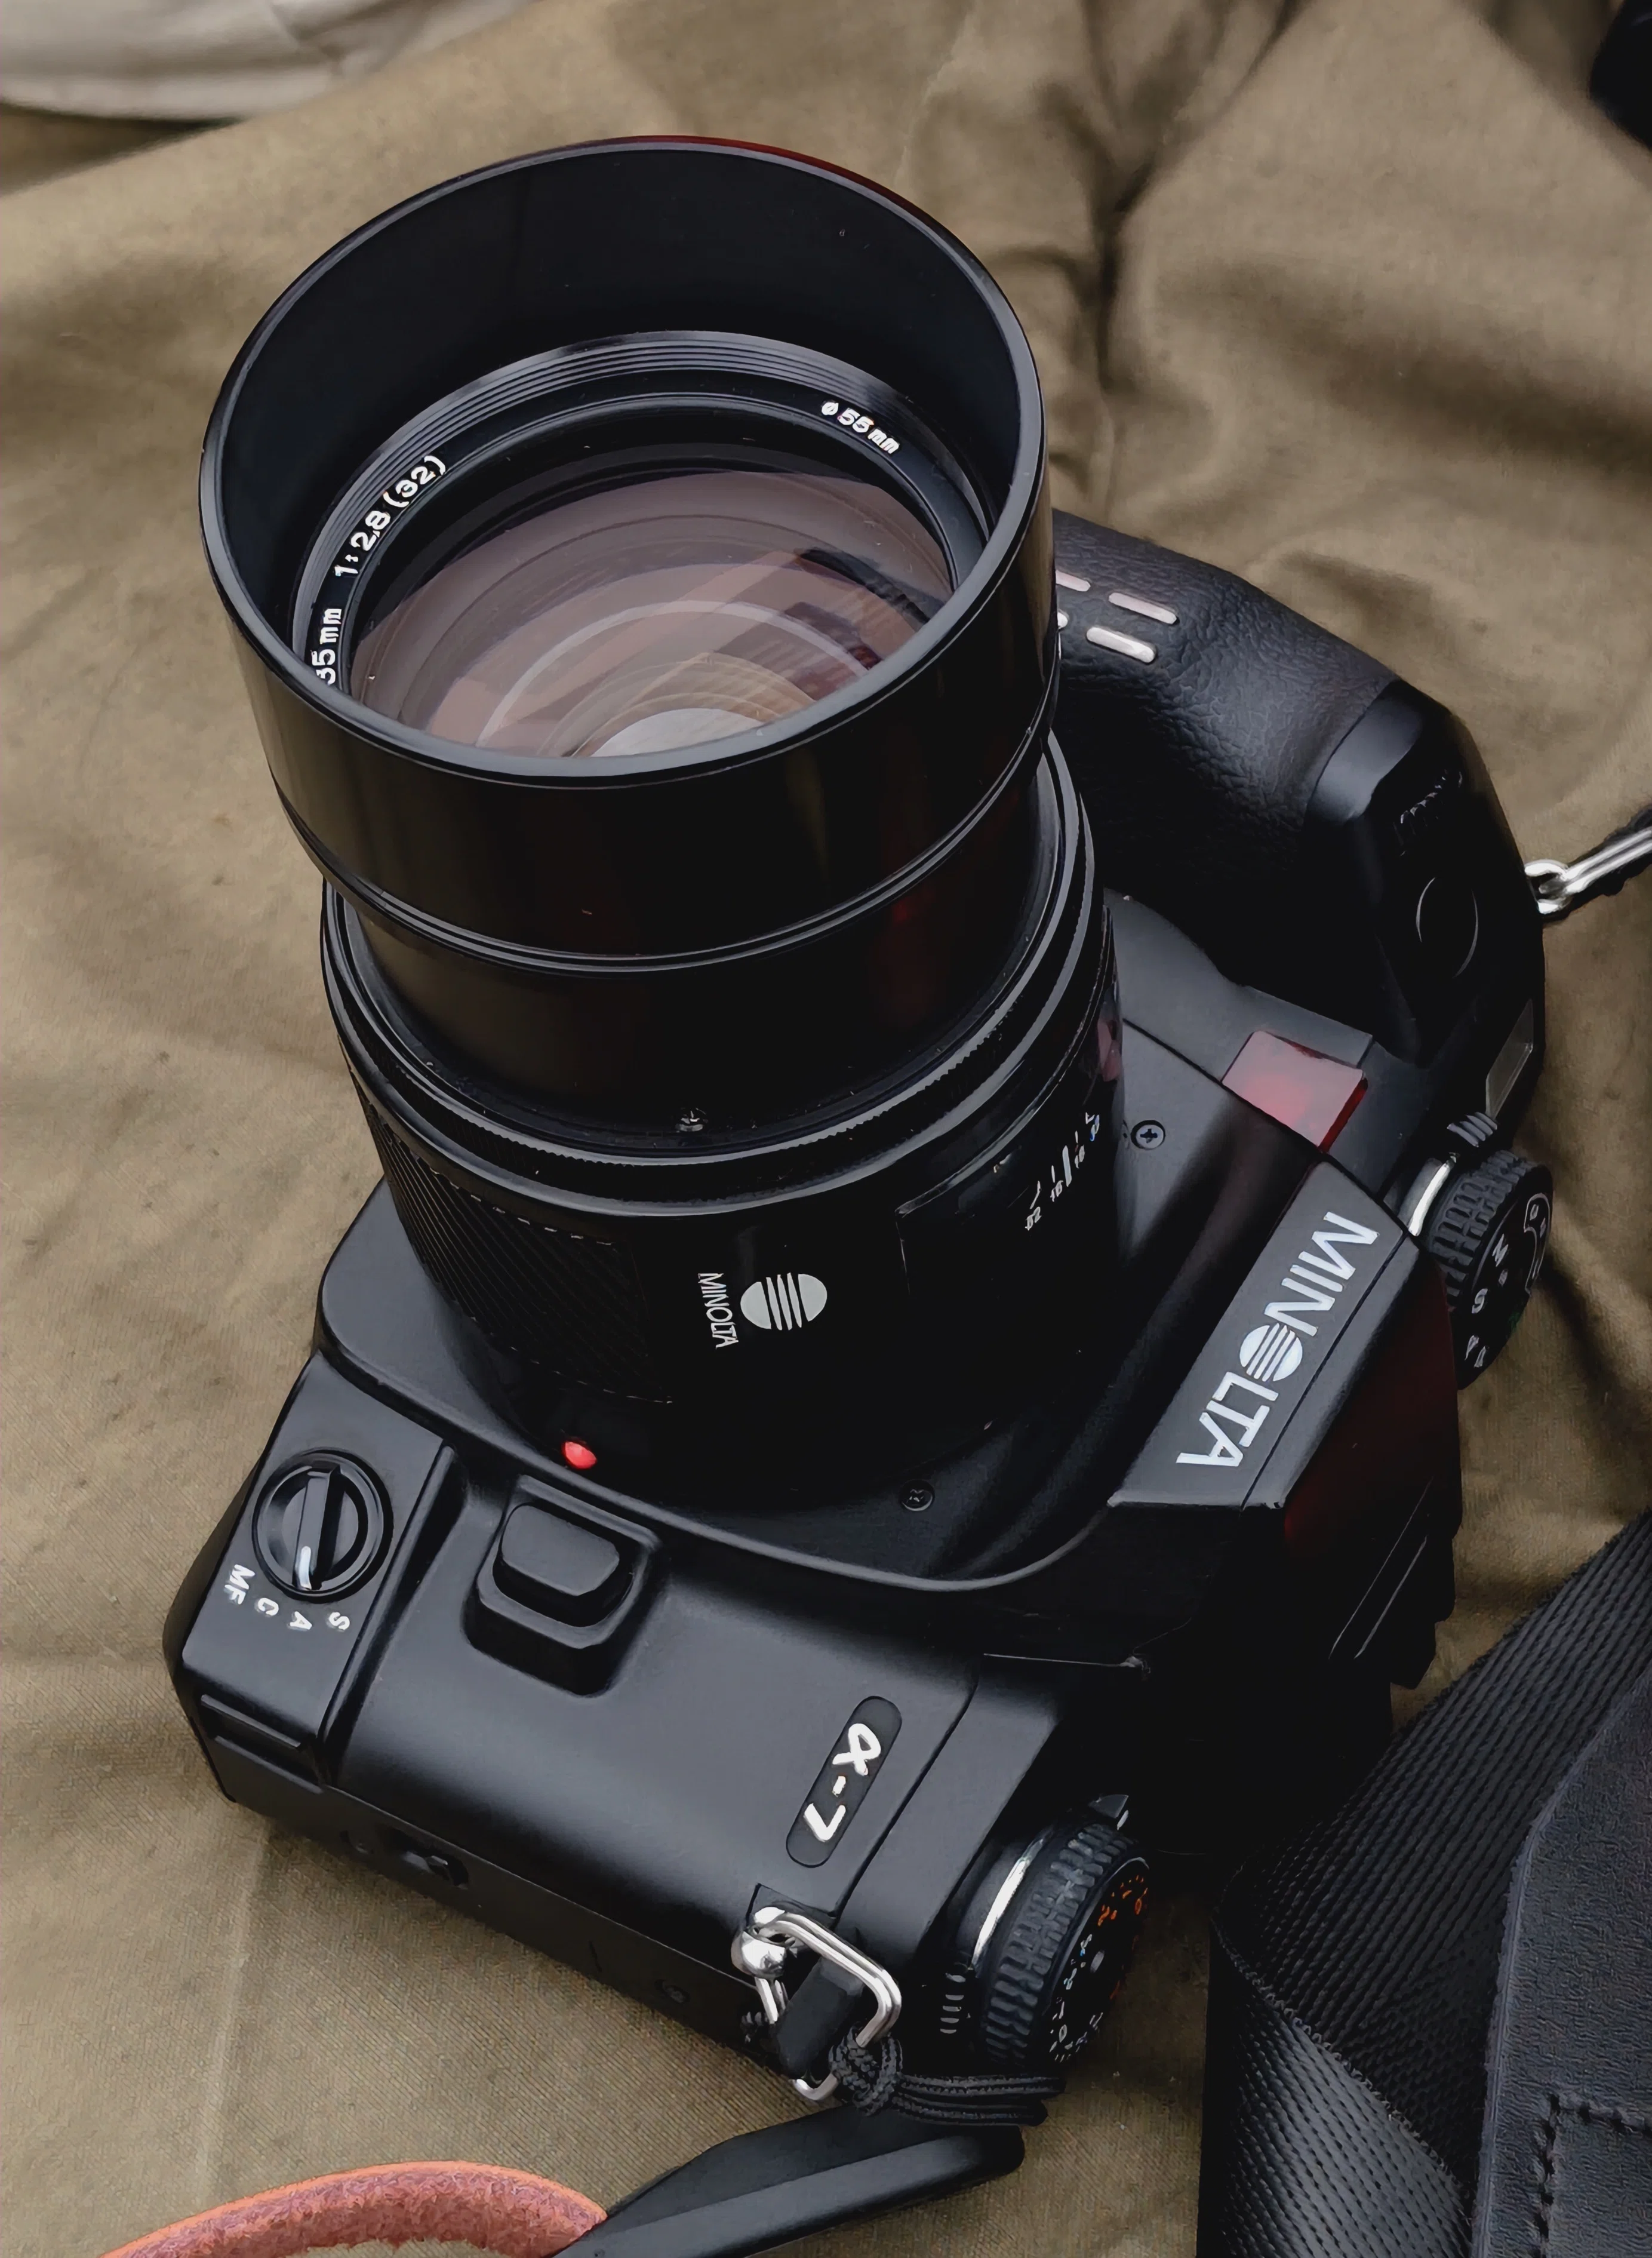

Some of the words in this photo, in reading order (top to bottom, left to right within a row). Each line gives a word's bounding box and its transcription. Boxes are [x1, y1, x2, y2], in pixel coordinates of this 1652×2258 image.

[697, 1272, 740, 1350] MINOLTA
[1175, 1211, 1380, 1467] MINOLTA
[223, 1563, 256, 1605] MF
[257, 1596, 280, 1617] C
[288, 1611, 313, 1630] A
[328, 1611, 351, 1631] S
